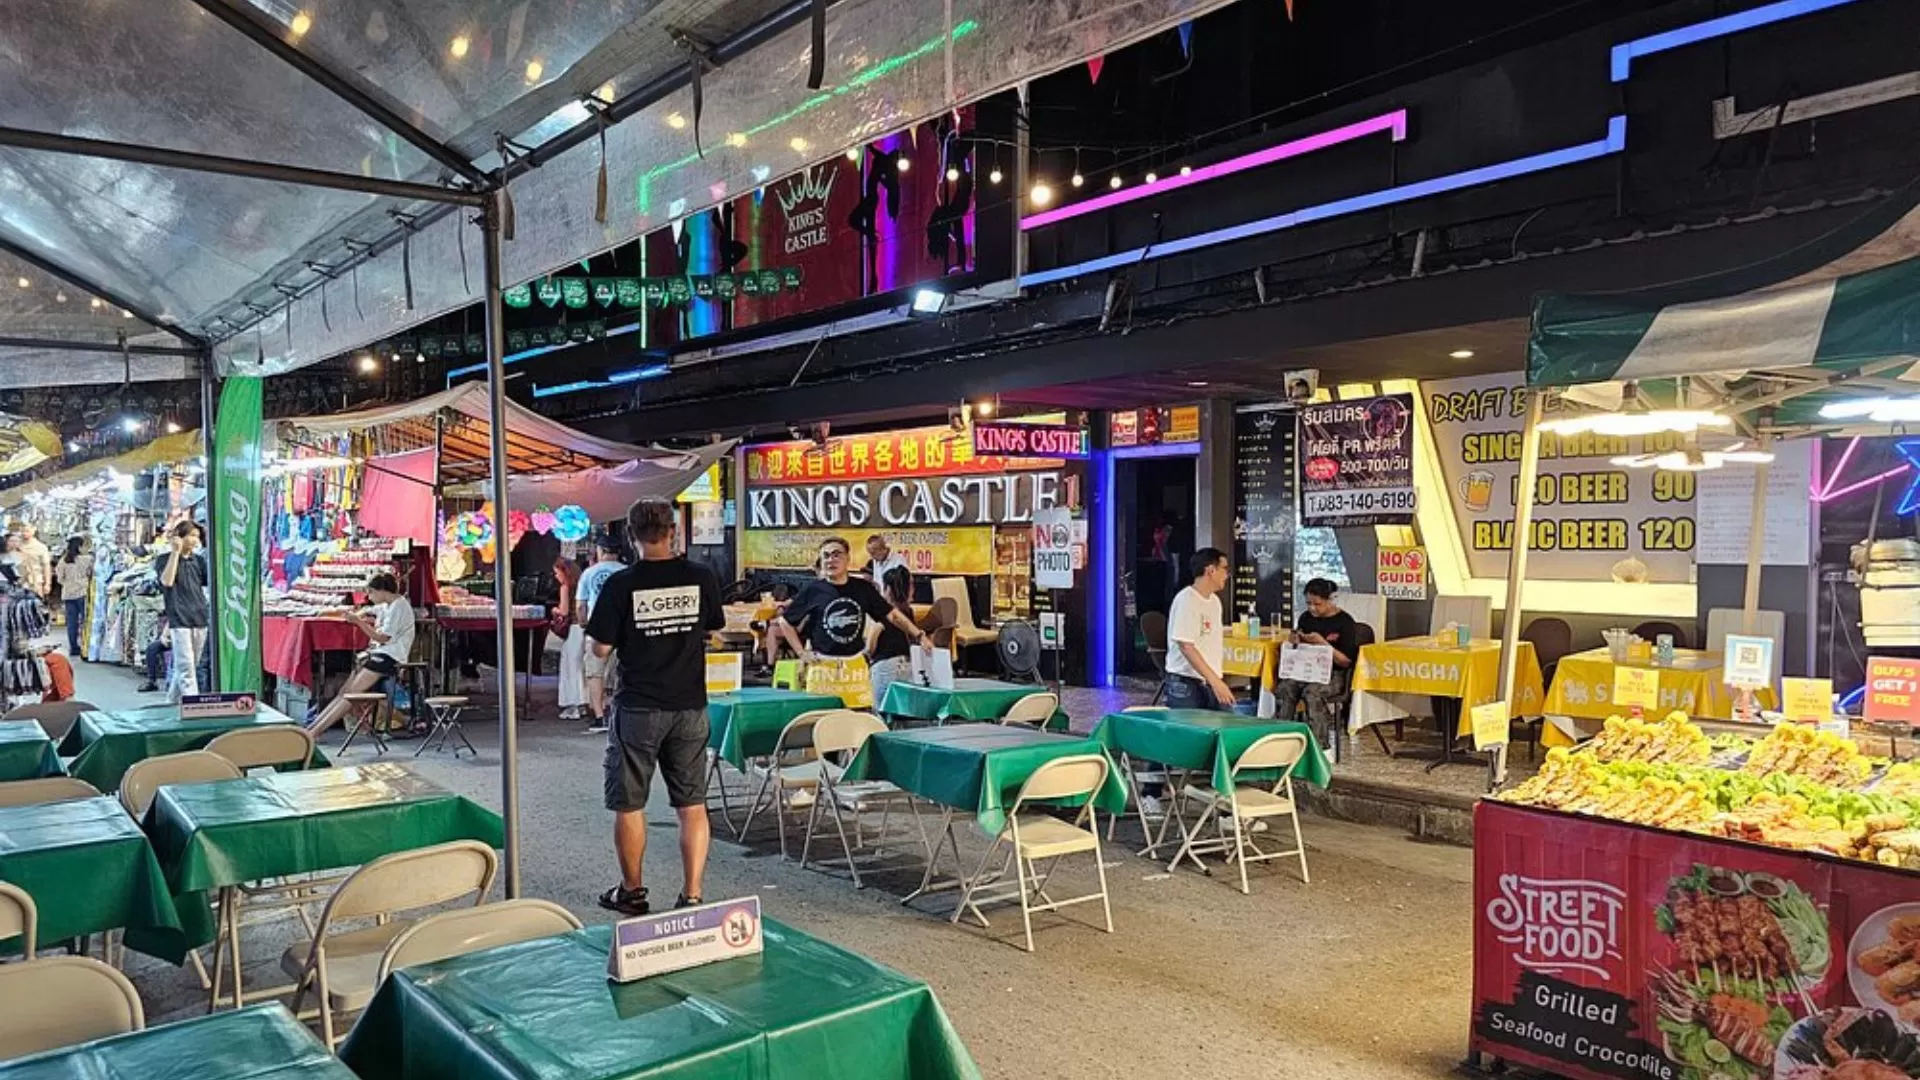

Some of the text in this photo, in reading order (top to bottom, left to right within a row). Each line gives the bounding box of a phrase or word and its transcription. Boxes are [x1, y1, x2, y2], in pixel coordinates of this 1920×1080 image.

[788, 207, 825, 232] KING'S
[785, 227, 827, 254] CASTLE
[1431, 386, 1506, 424] DRAFT
[976, 427, 1026, 453] KING'S
[1030, 430, 1080, 455] CASTLE
[1462, 430, 1557, 463] SINGA
[749, 482, 870, 527] KING'S
[879, 472, 1059, 525] CASTLE
[1559, 472, 1629, 504] BEER
[1652, 469, 1696, 502] 90
[1559, 519, 1628, 551] BEER
[1640, 518, 1696, 551] 120
[224, 489, 251, 651] Chang
[1037, 552, 1070, 571] PHOTO
[1380, 552, 1402, 567] NO
[1379, 571, 1422, 584] GUIDE
[652, 595, 697, 612] GERRY
[1383, 660, 1460, 681] SINGHA
[1873, 679, 1907, 691] GET
[1873, 693, 1911, 706] FREE
[1486, 873, 1624, 948] STREET
[654, 916, 696, 935] NOTICE
[626, 935, 717, 960] NO OUTSIDE BEER ALLOWED
[1524, 923, 1605, 960] FOOD
[1534, 984, 1618, 1025] Grilled
[1490, 1012, 1673, 1080] Seafood Crocodile
